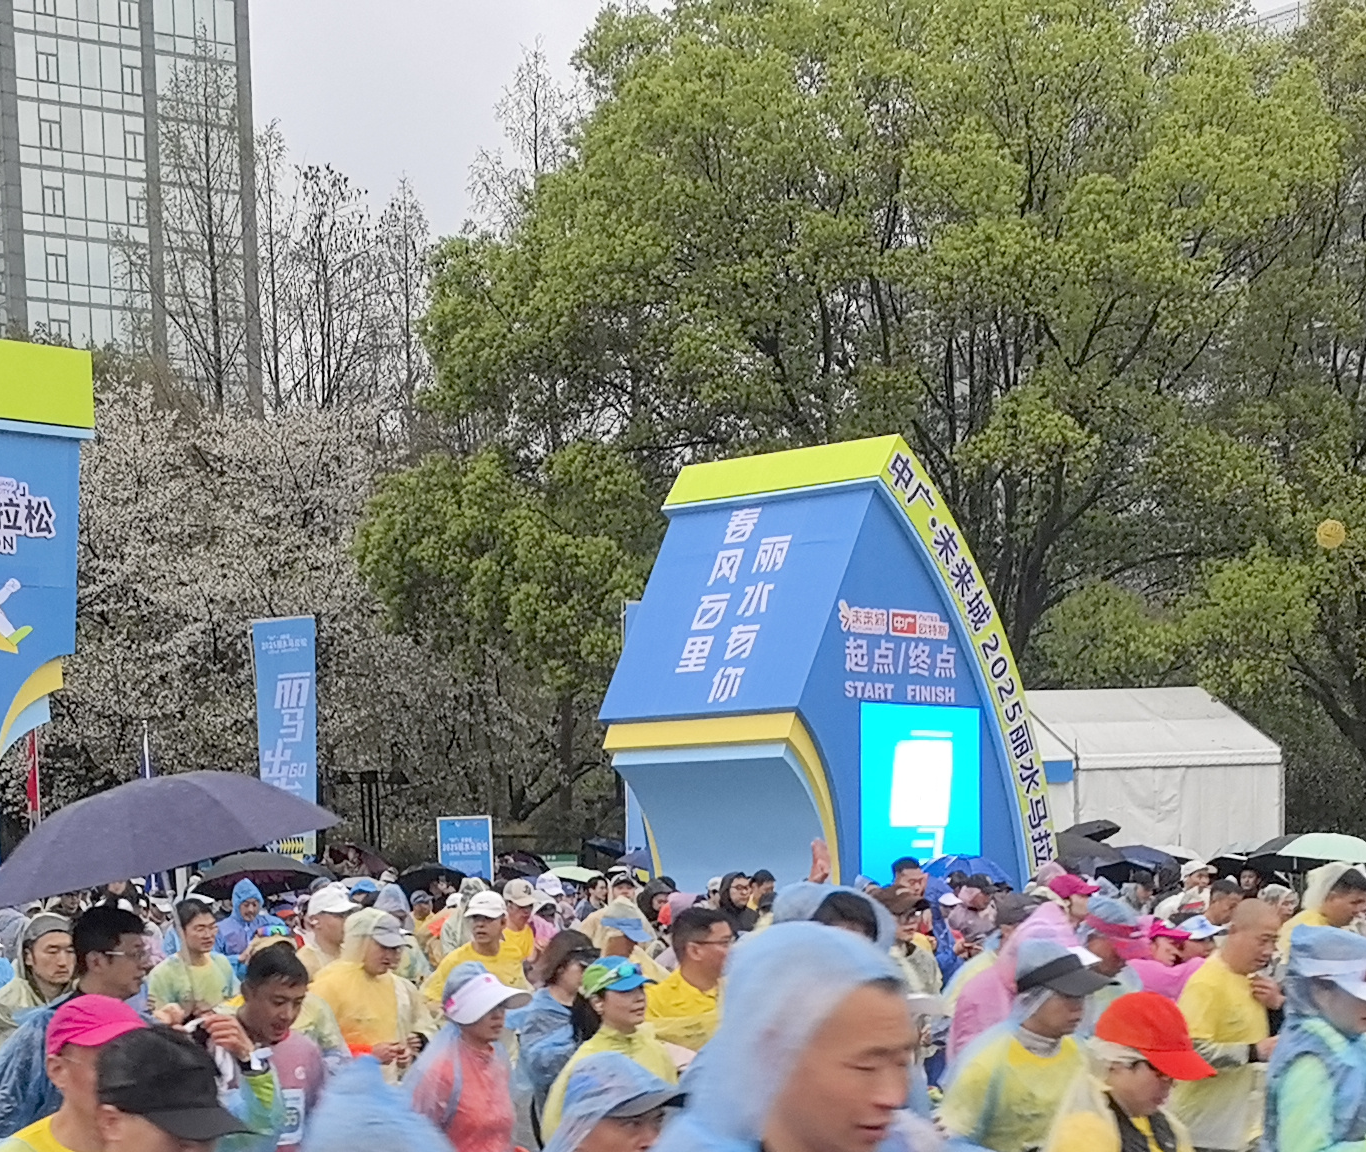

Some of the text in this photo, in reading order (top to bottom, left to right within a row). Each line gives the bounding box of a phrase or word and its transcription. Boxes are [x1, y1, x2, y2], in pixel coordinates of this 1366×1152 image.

[844, 636, 957, 680] 起点/终点
[844, 680, 956, 704] START FINISH
